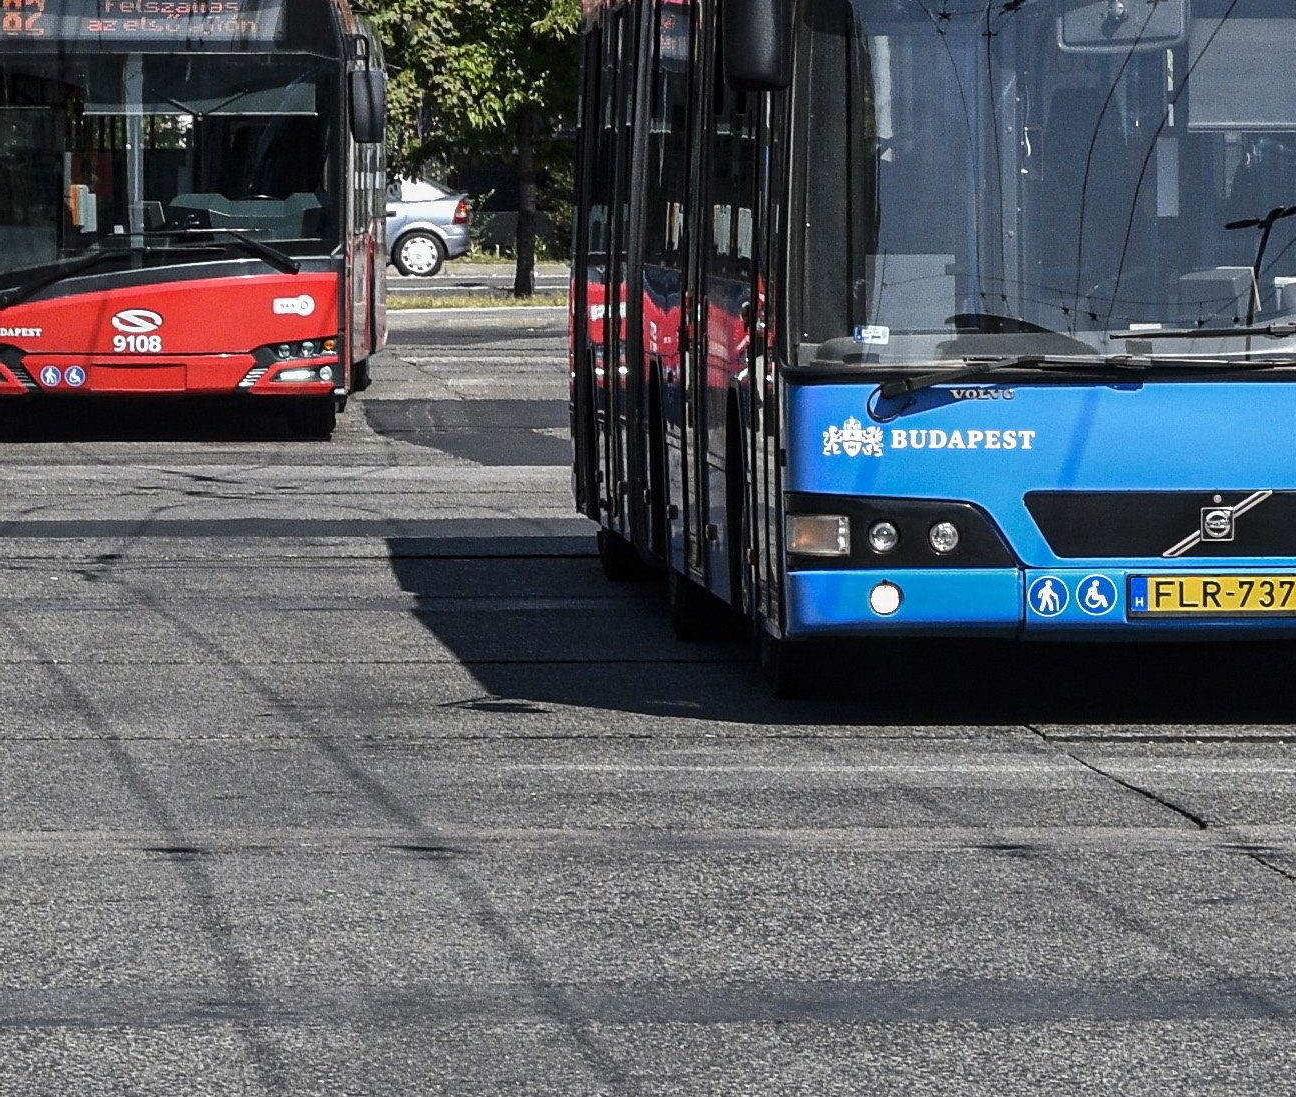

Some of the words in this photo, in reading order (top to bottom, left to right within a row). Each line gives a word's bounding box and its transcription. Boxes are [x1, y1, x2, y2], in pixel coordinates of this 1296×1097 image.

[113, 335, 162, 352] 9108
[891, 429, 1036, 450] BUDAPEST
[1135, 596, 1144, 607] H
[1154, 580, 1296, 608] FLR-737
